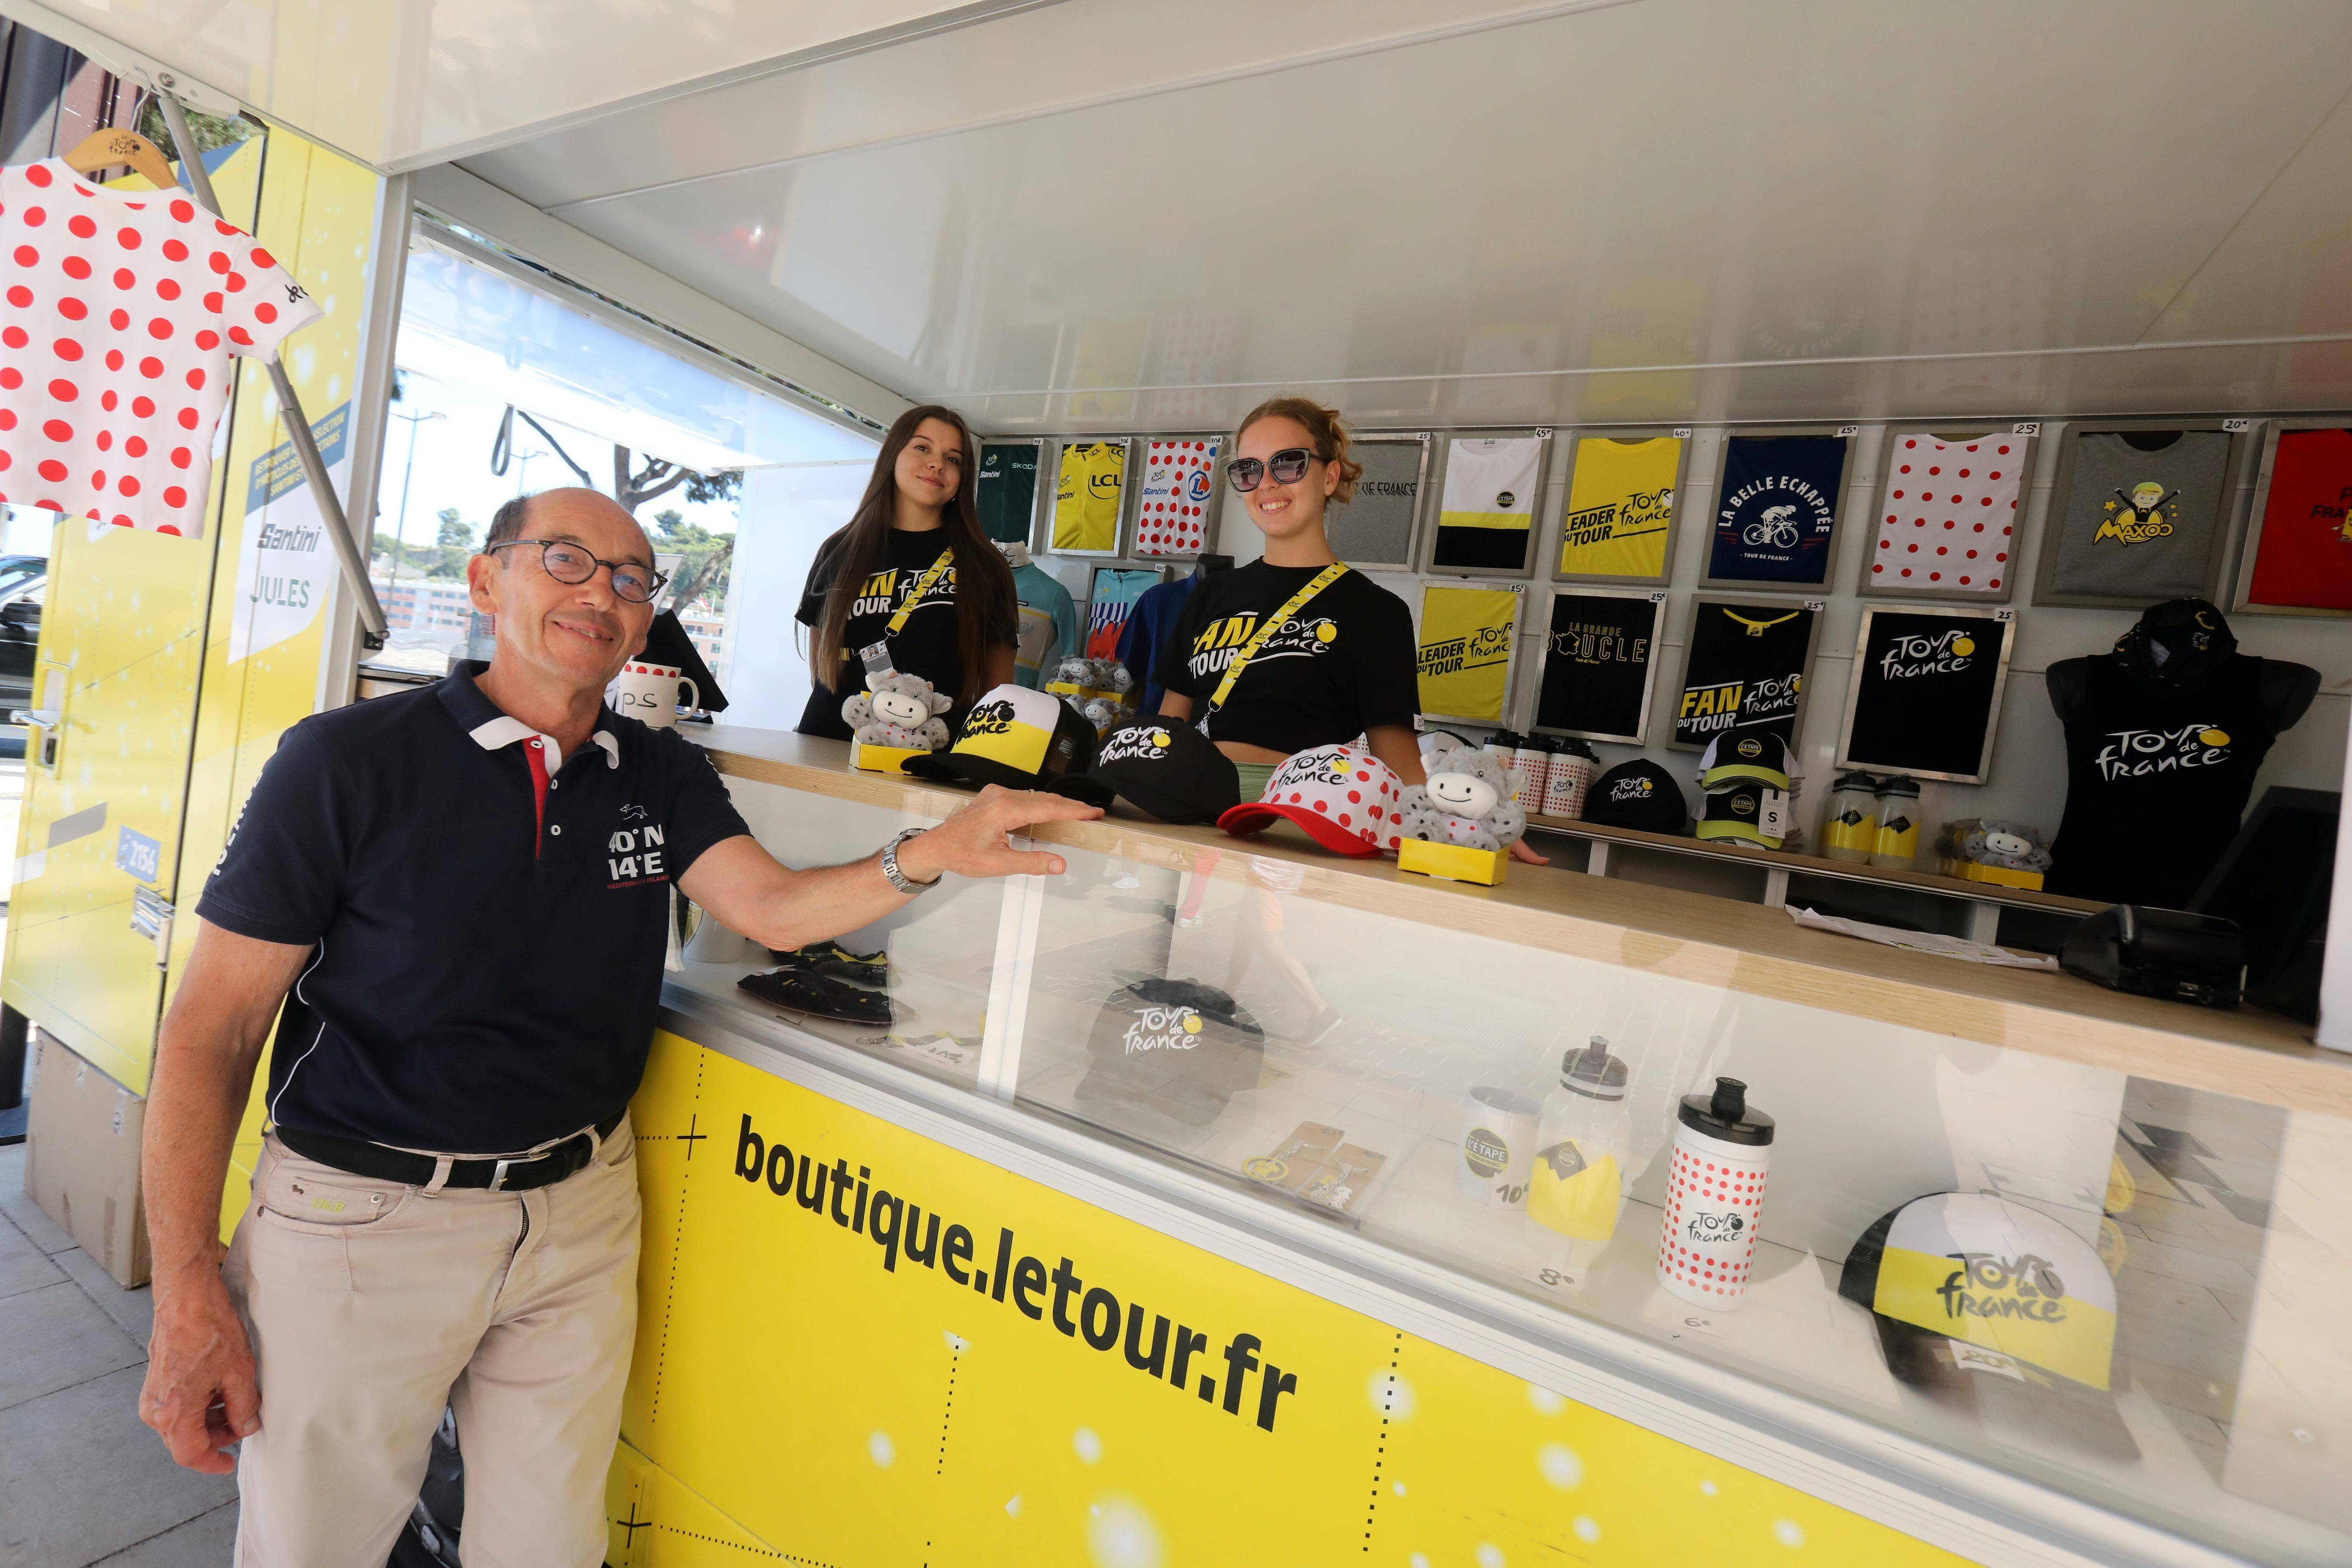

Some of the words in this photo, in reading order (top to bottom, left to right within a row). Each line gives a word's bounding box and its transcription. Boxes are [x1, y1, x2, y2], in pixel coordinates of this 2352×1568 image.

[1718, 510, 1735, 527] LA
[1729, 476, 1773, 508] BELLE
[255, 523, 323, 553] Santini
[1573, 525, 1613, 547] TOUR
[249, 575, 310, 609] JULES
[1997, 611, 2012, 620] 25
[1303, 628, 1316, 638] de
[1569, 622, 1580, 631] LA
[1583, 624, 1622, 637] GRANDE
[1418, 641, 1466, 664] LEADER
[1937, 648, 1951, 659] de
[1416, 664, 1428, 674] DU
[1427, 656, 1464, 677] TOUR
[1679, 685, 1743, 718] FAN
[1677, 718, 1692, 728] DU
[1691, 712, 1737, 733] TOUR
[1139, 737, 1152, 747] de
[2179, 740, 2199, 753] de
[1768, 812, 1778, 823] S
[1169, 1023, 1184, 1035] de
[1467, 1137, 1505, 1162] L'ÉTAPE
[733, 1113, 1298, 1433] boutique.letour.fr
